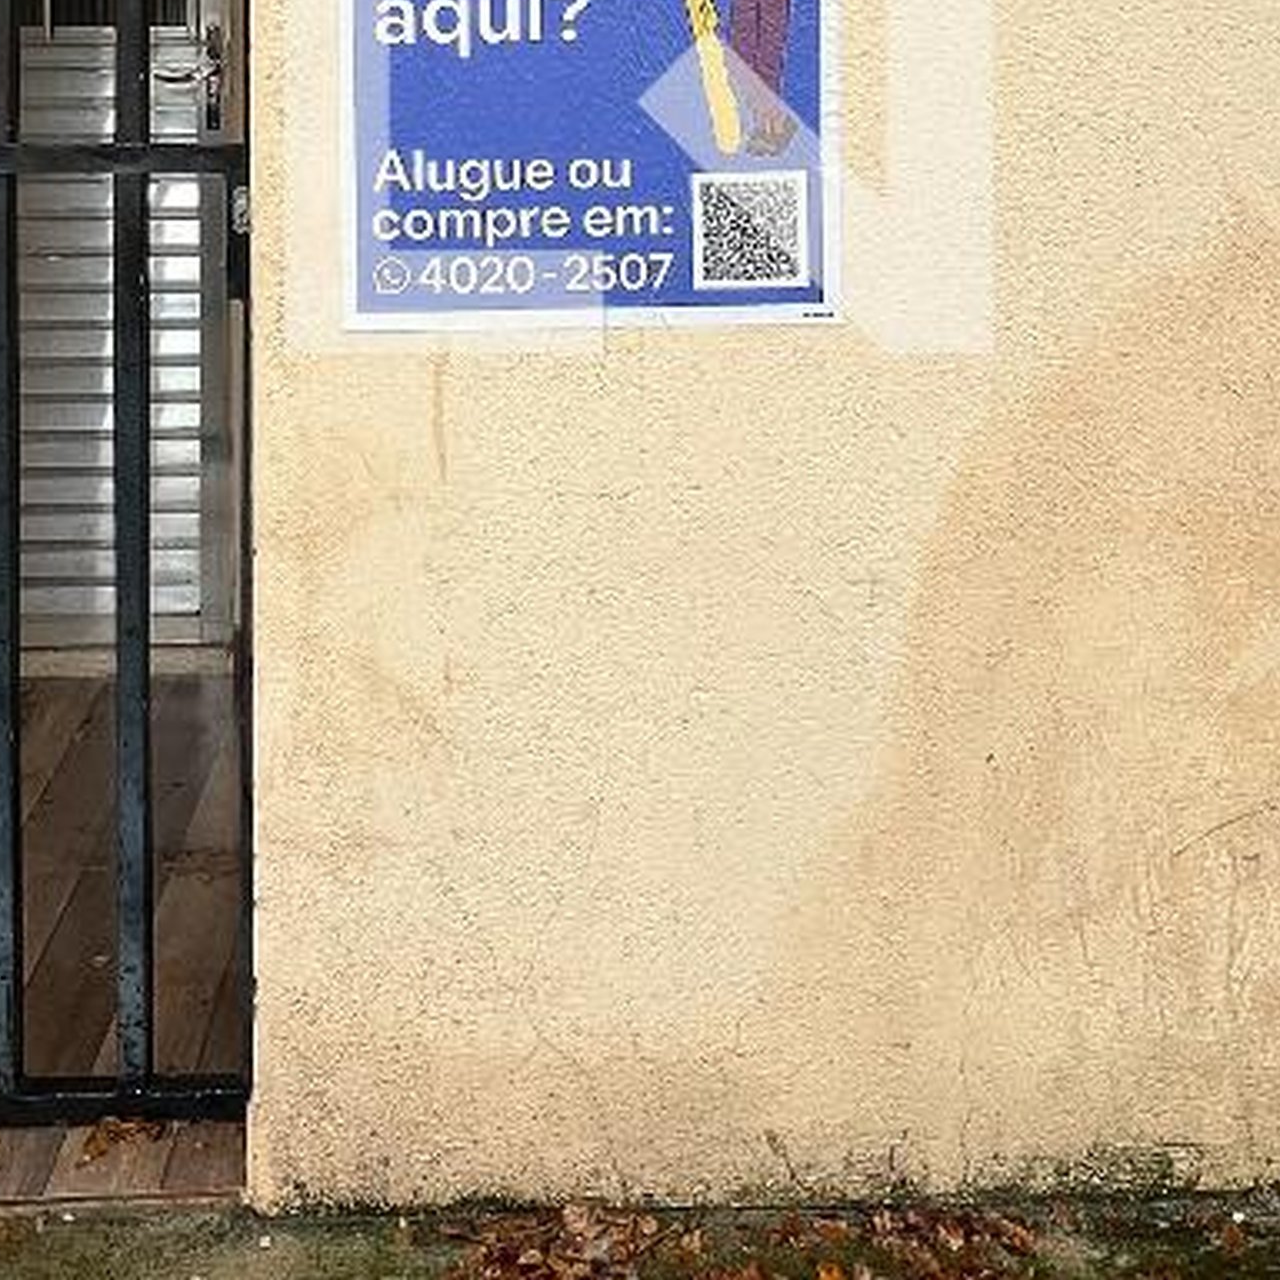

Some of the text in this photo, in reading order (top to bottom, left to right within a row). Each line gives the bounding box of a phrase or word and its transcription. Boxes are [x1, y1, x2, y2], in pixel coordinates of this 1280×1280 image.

[373, 149, 632, 201] Alugue ou
[372, 203, 675, 247] compre em:
